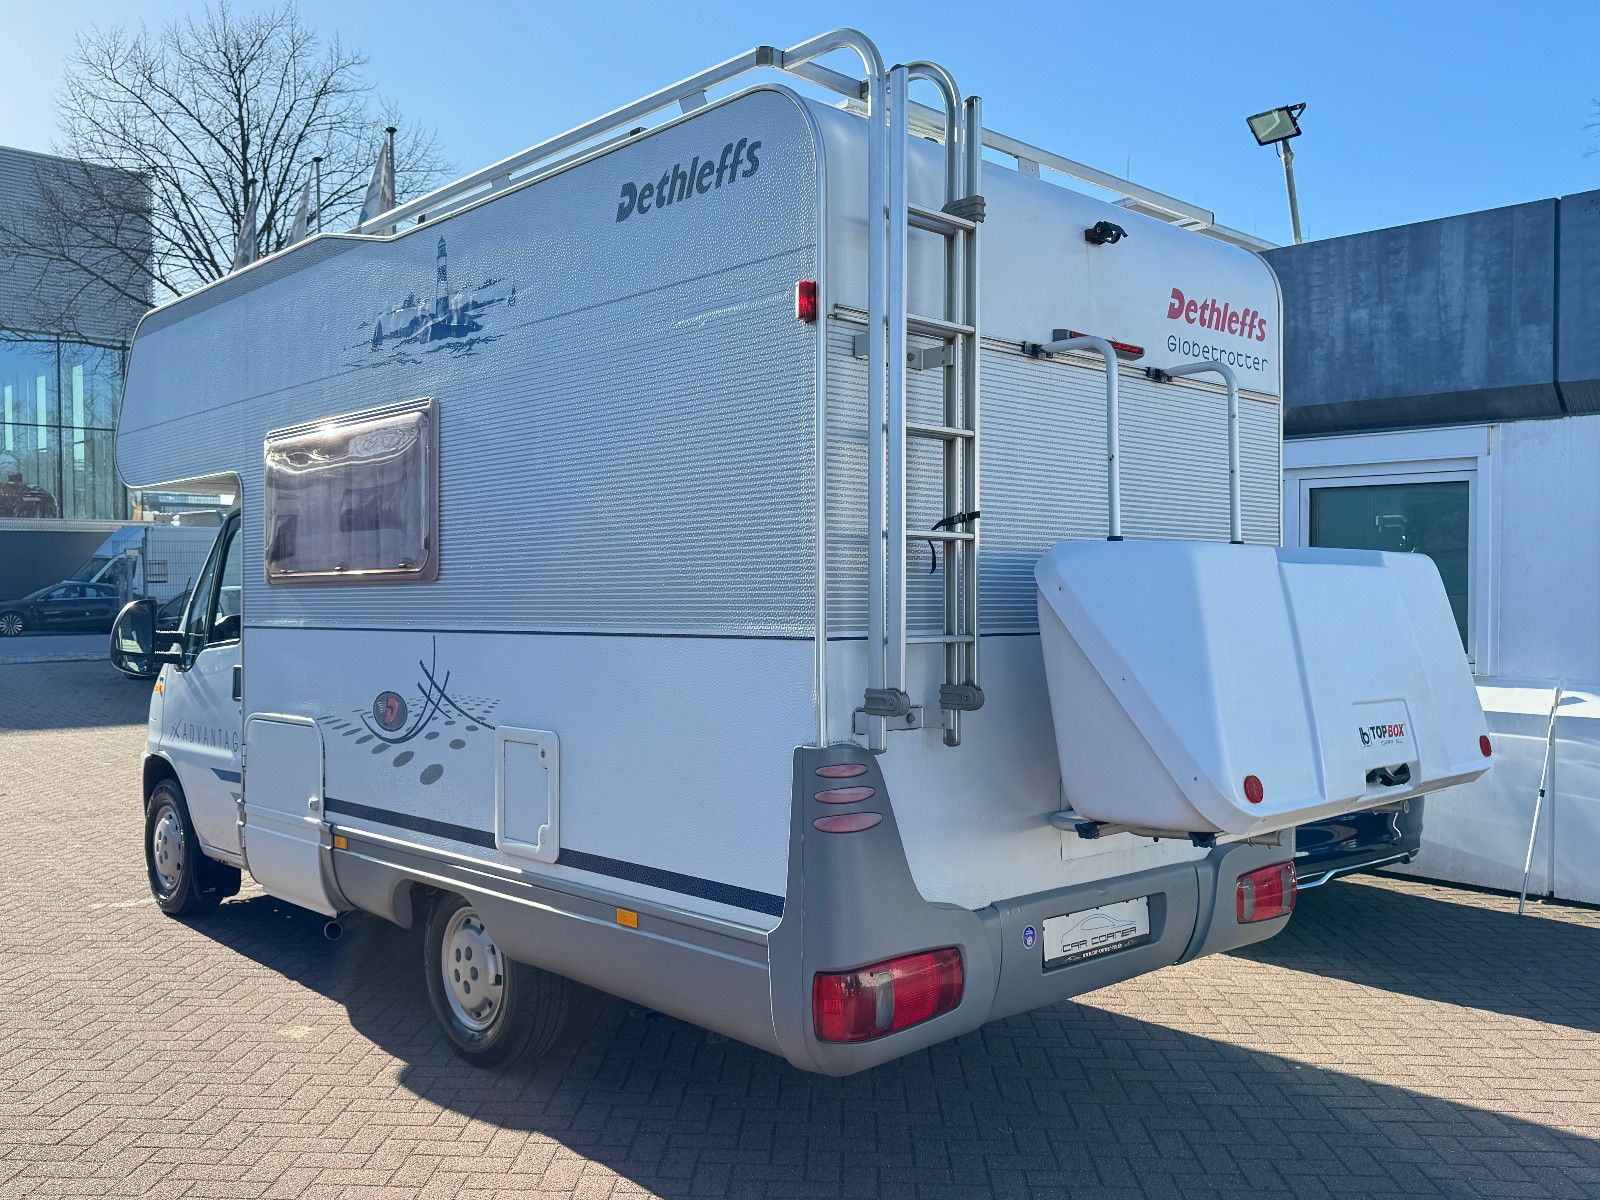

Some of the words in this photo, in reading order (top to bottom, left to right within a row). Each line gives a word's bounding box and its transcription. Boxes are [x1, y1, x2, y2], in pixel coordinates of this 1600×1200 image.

[616, 137, 762, 223] Dethleffs
[1166, 287, 1267, 342] Dethleffs
[1167, 334, 1269, 372] Globetrotter
[1062, 939, 1088, 953] CAR
[1091, 926, 1137, 946] CORNER
